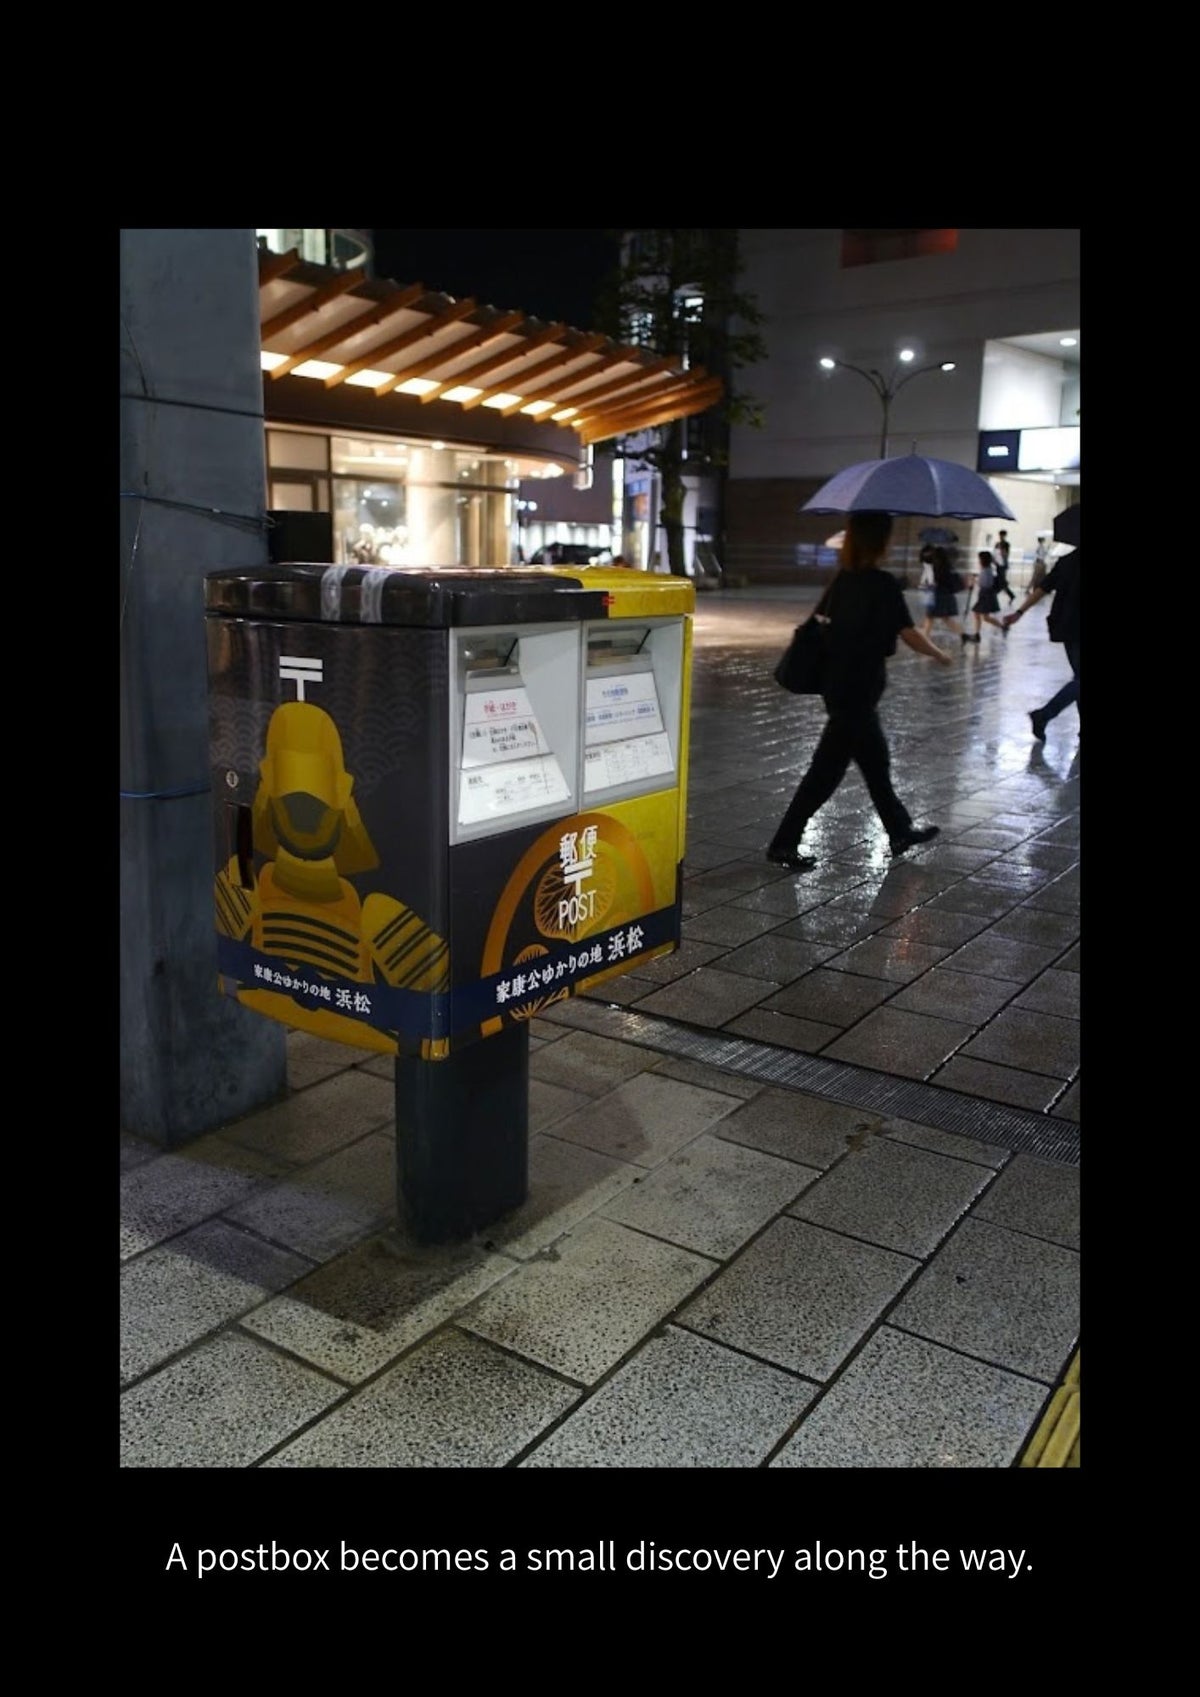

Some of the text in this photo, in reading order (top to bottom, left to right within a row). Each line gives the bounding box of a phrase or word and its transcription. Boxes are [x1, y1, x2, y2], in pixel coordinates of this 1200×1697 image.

[559, 825, 598, 868] 郵便
[558, 890, 597, 930] POST
[496, 925, 644, 1003] 家康公ゆかりの地 浜松
[253, 964, 372, 1014] 家康公ゆかりの地 浜松
